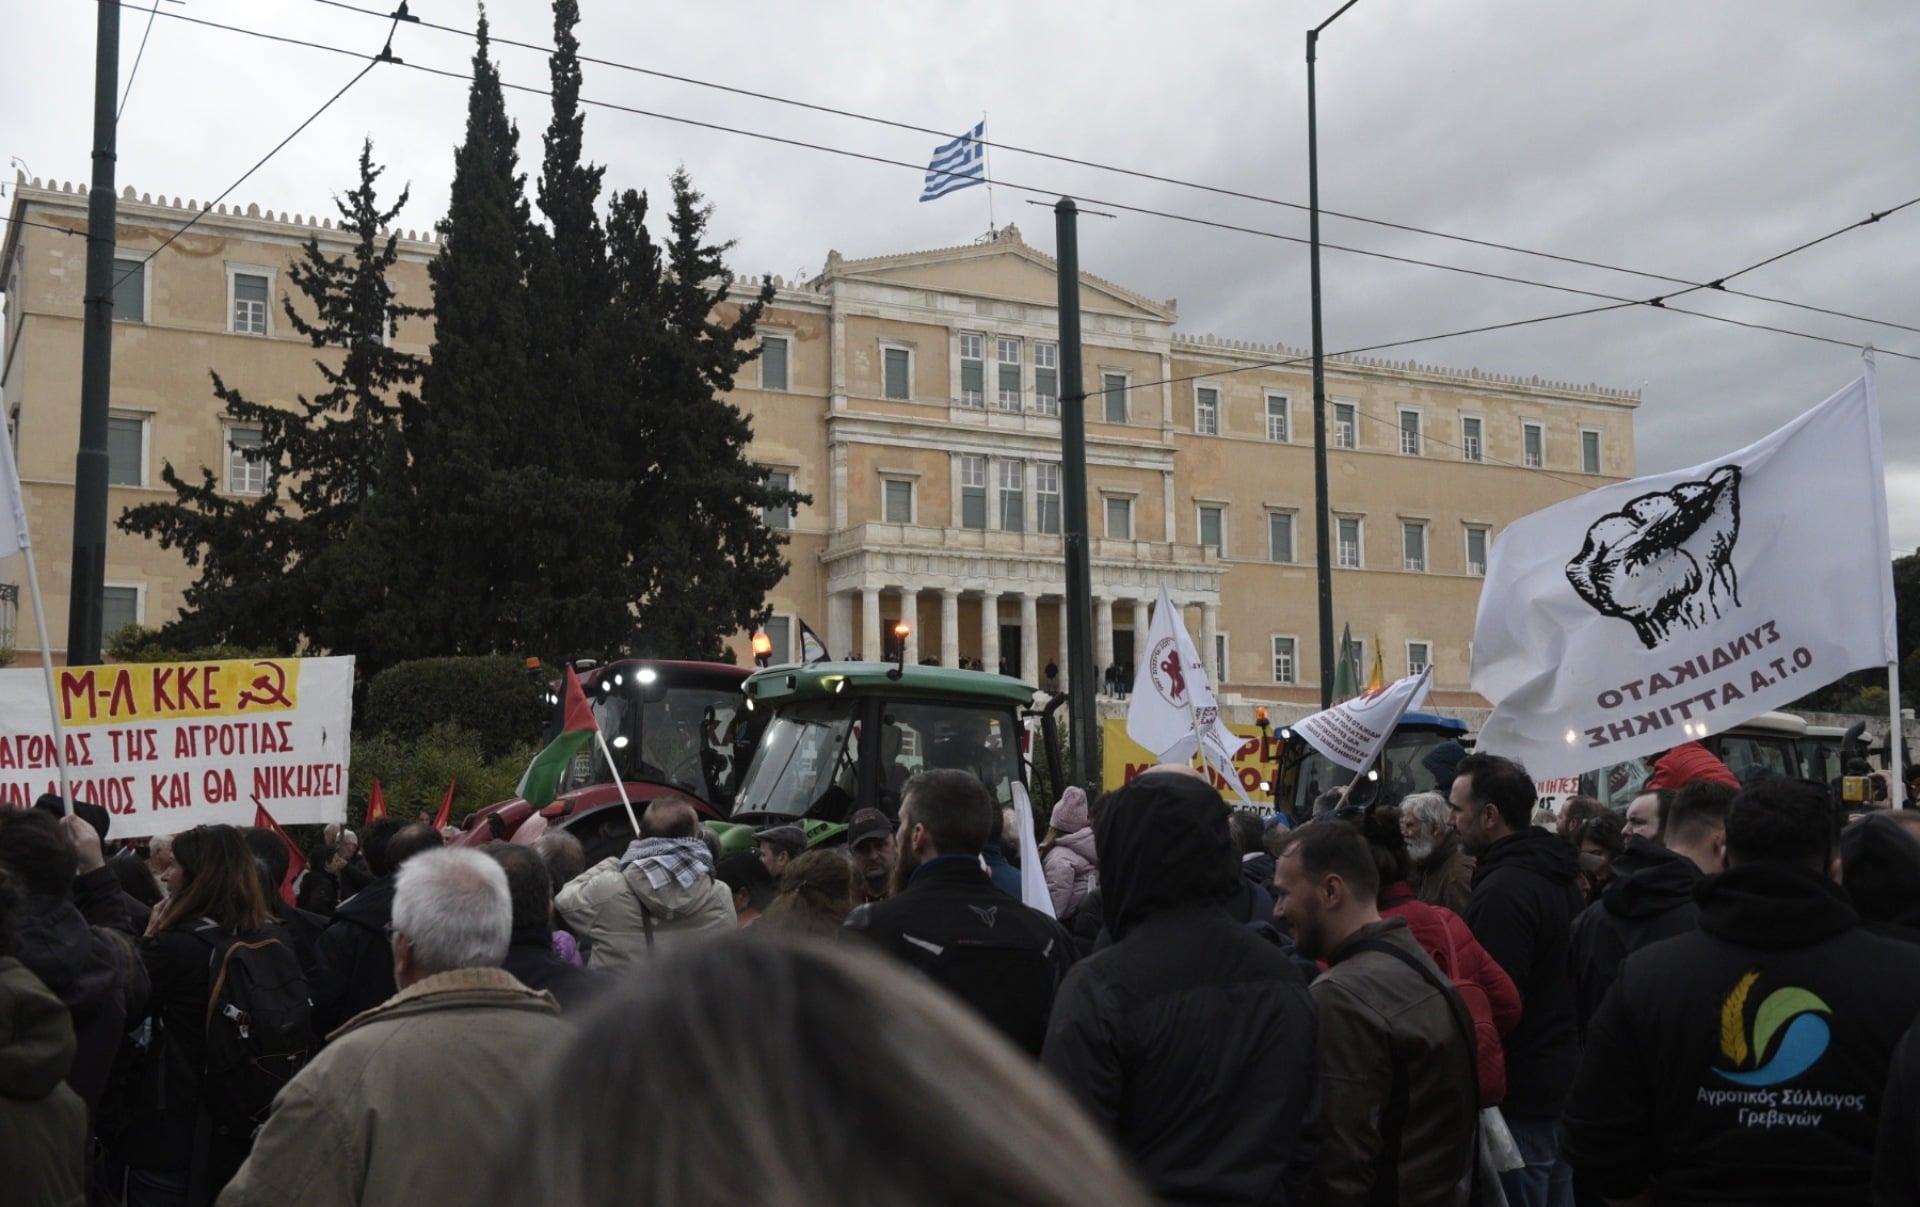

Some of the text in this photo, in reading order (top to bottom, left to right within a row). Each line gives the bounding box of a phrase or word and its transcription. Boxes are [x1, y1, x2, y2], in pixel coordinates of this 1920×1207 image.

[61, 665, 222, 720] Μ-Λ ΚΚΕ
[0, 720, 295, 769] ΑΓΩΝΑΣ ΤΗΣ ΑΓΡΟΤΙΑΣ
[47, 776, 137, 815] ΚΑΙΟΣ
[151, 771, 192, 811] ΚΑΙ
[203, 768, 238, 804] ΘΑ
[253, 763, 342, 799] ΝΙΚΗΣΕΙ
[1695, 1086, 1866, 1111] Αγροτικός Σύλλογος
[1738, 1109, 1822, 1128] Γρεβενών
